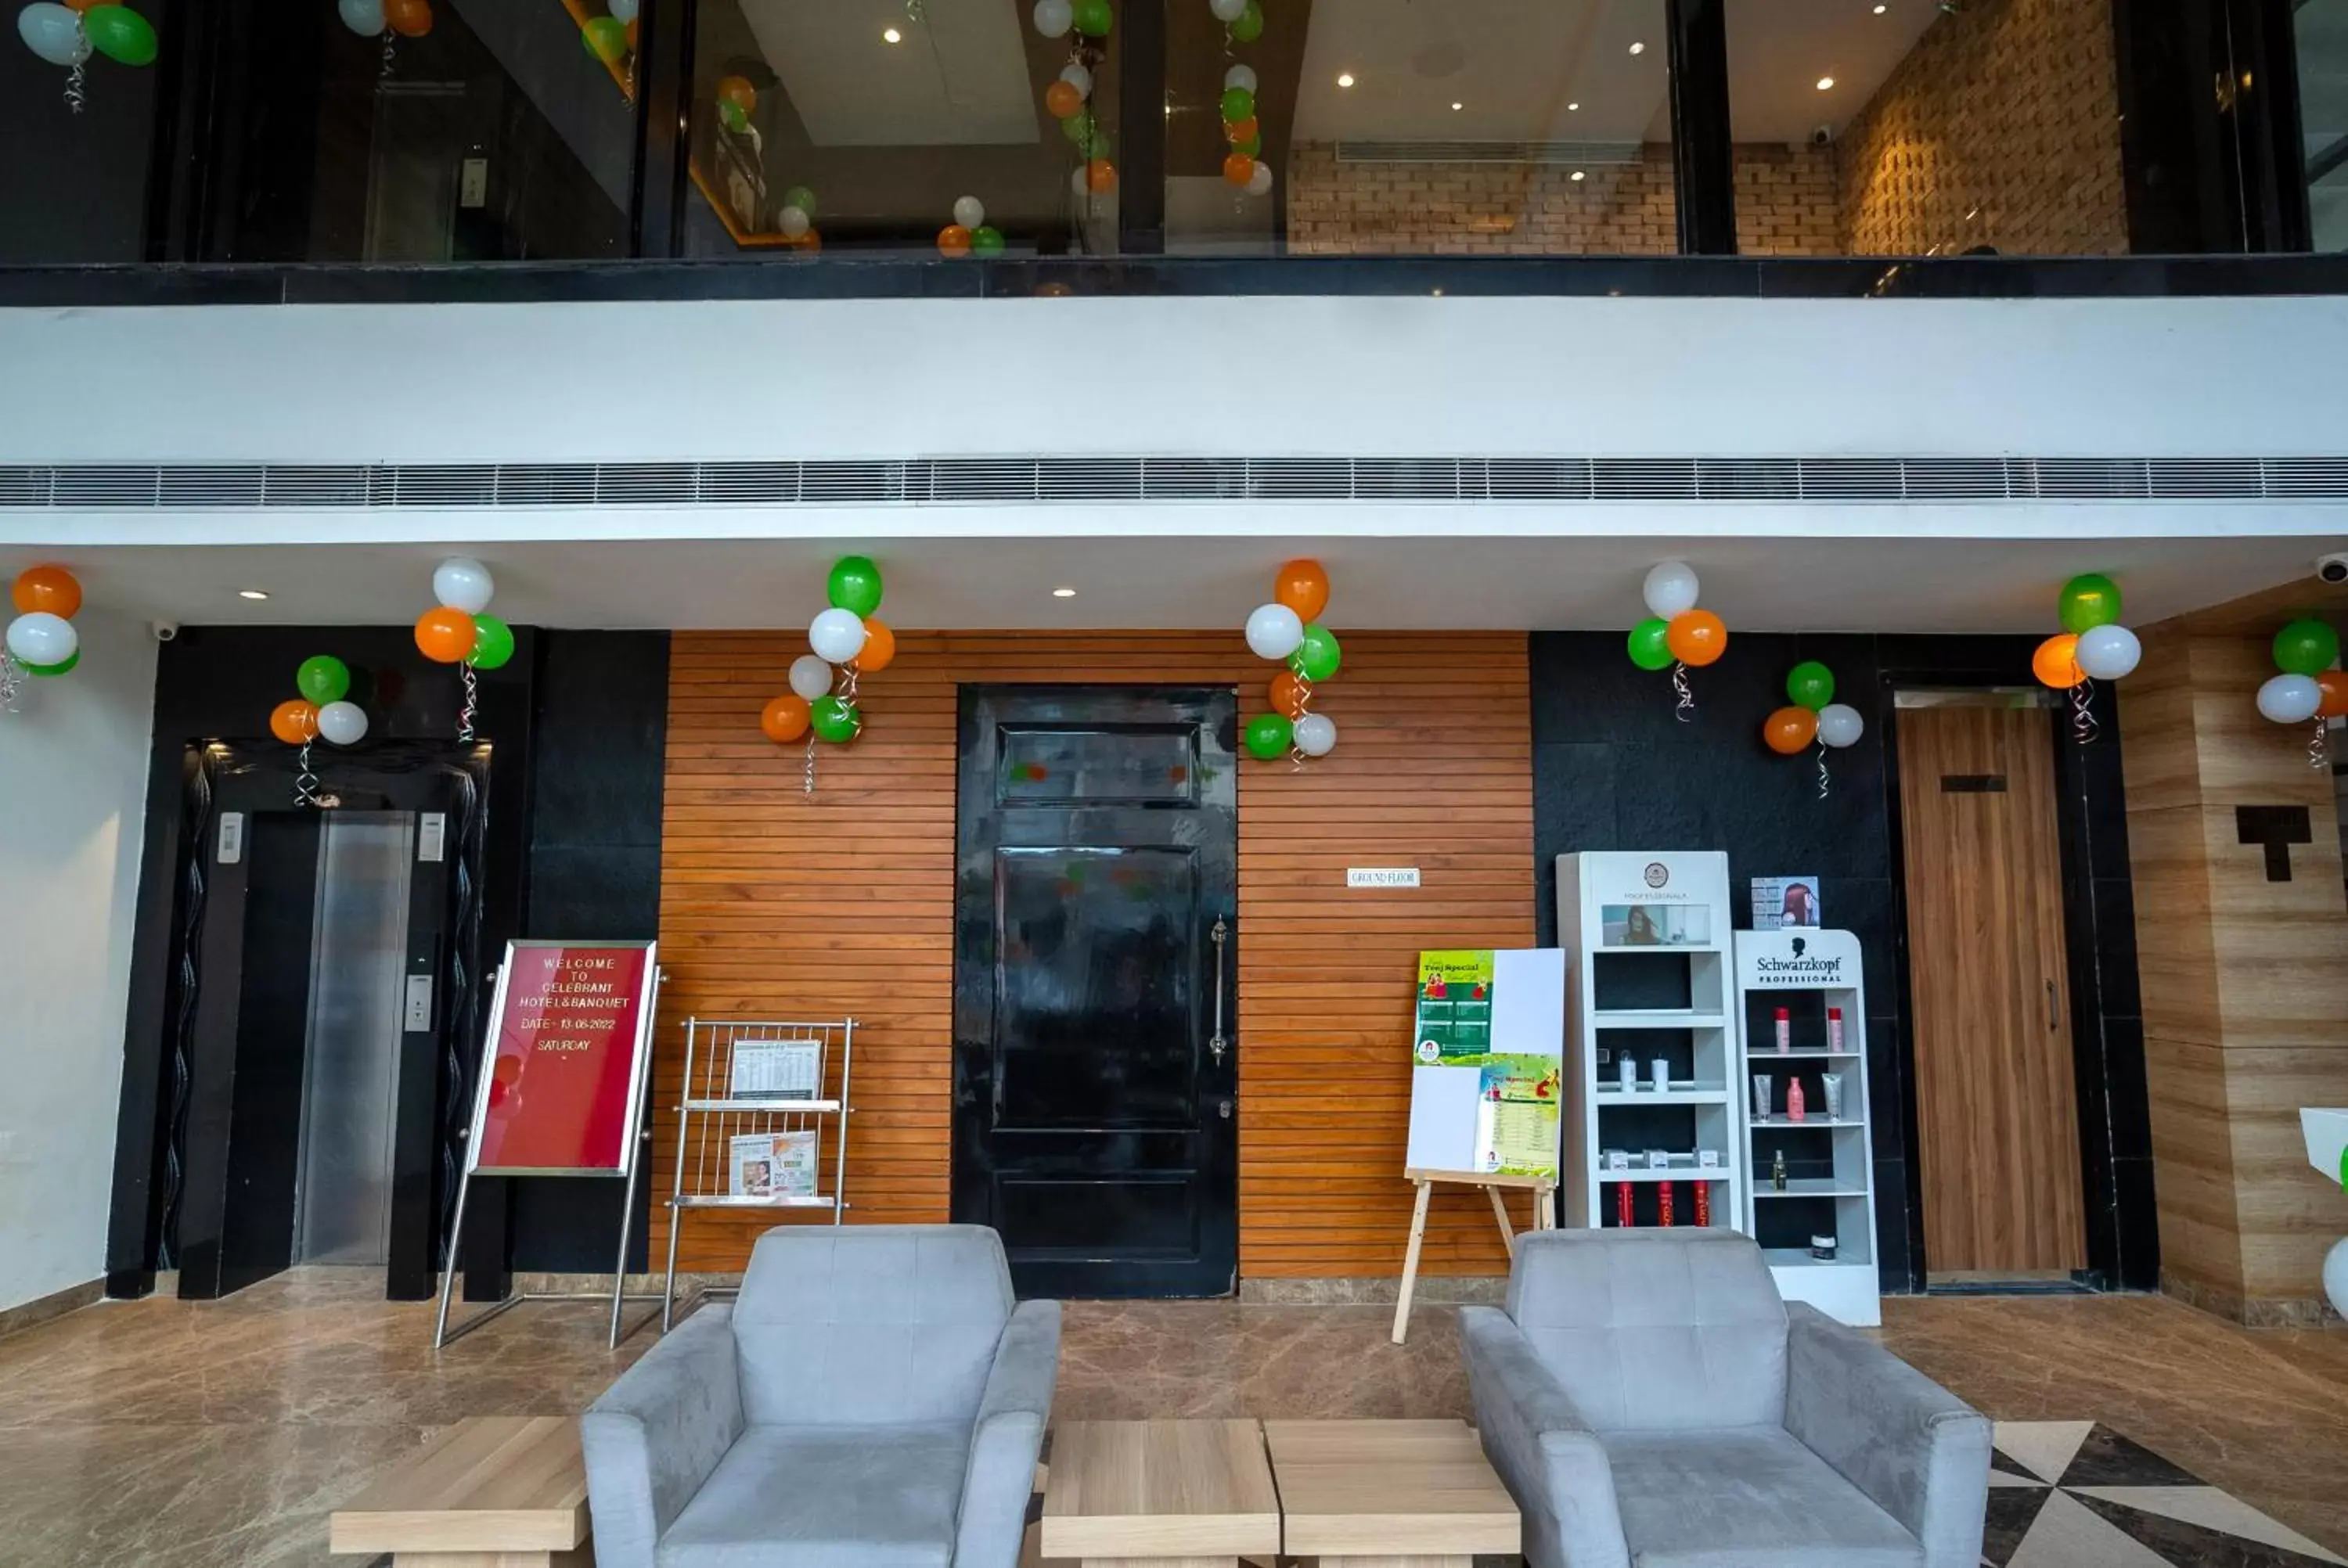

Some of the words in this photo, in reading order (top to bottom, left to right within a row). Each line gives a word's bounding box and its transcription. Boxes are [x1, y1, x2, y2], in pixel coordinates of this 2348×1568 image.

[543, 958, 615, 969] WELCOME
[1756, 956, 1842, 974] Schwarzkopf
[571, 971, 588, 982] TO
[542, 982, 614, 993] CELEBRANT
[538, 1039, 592, 1051] SATURDAY
